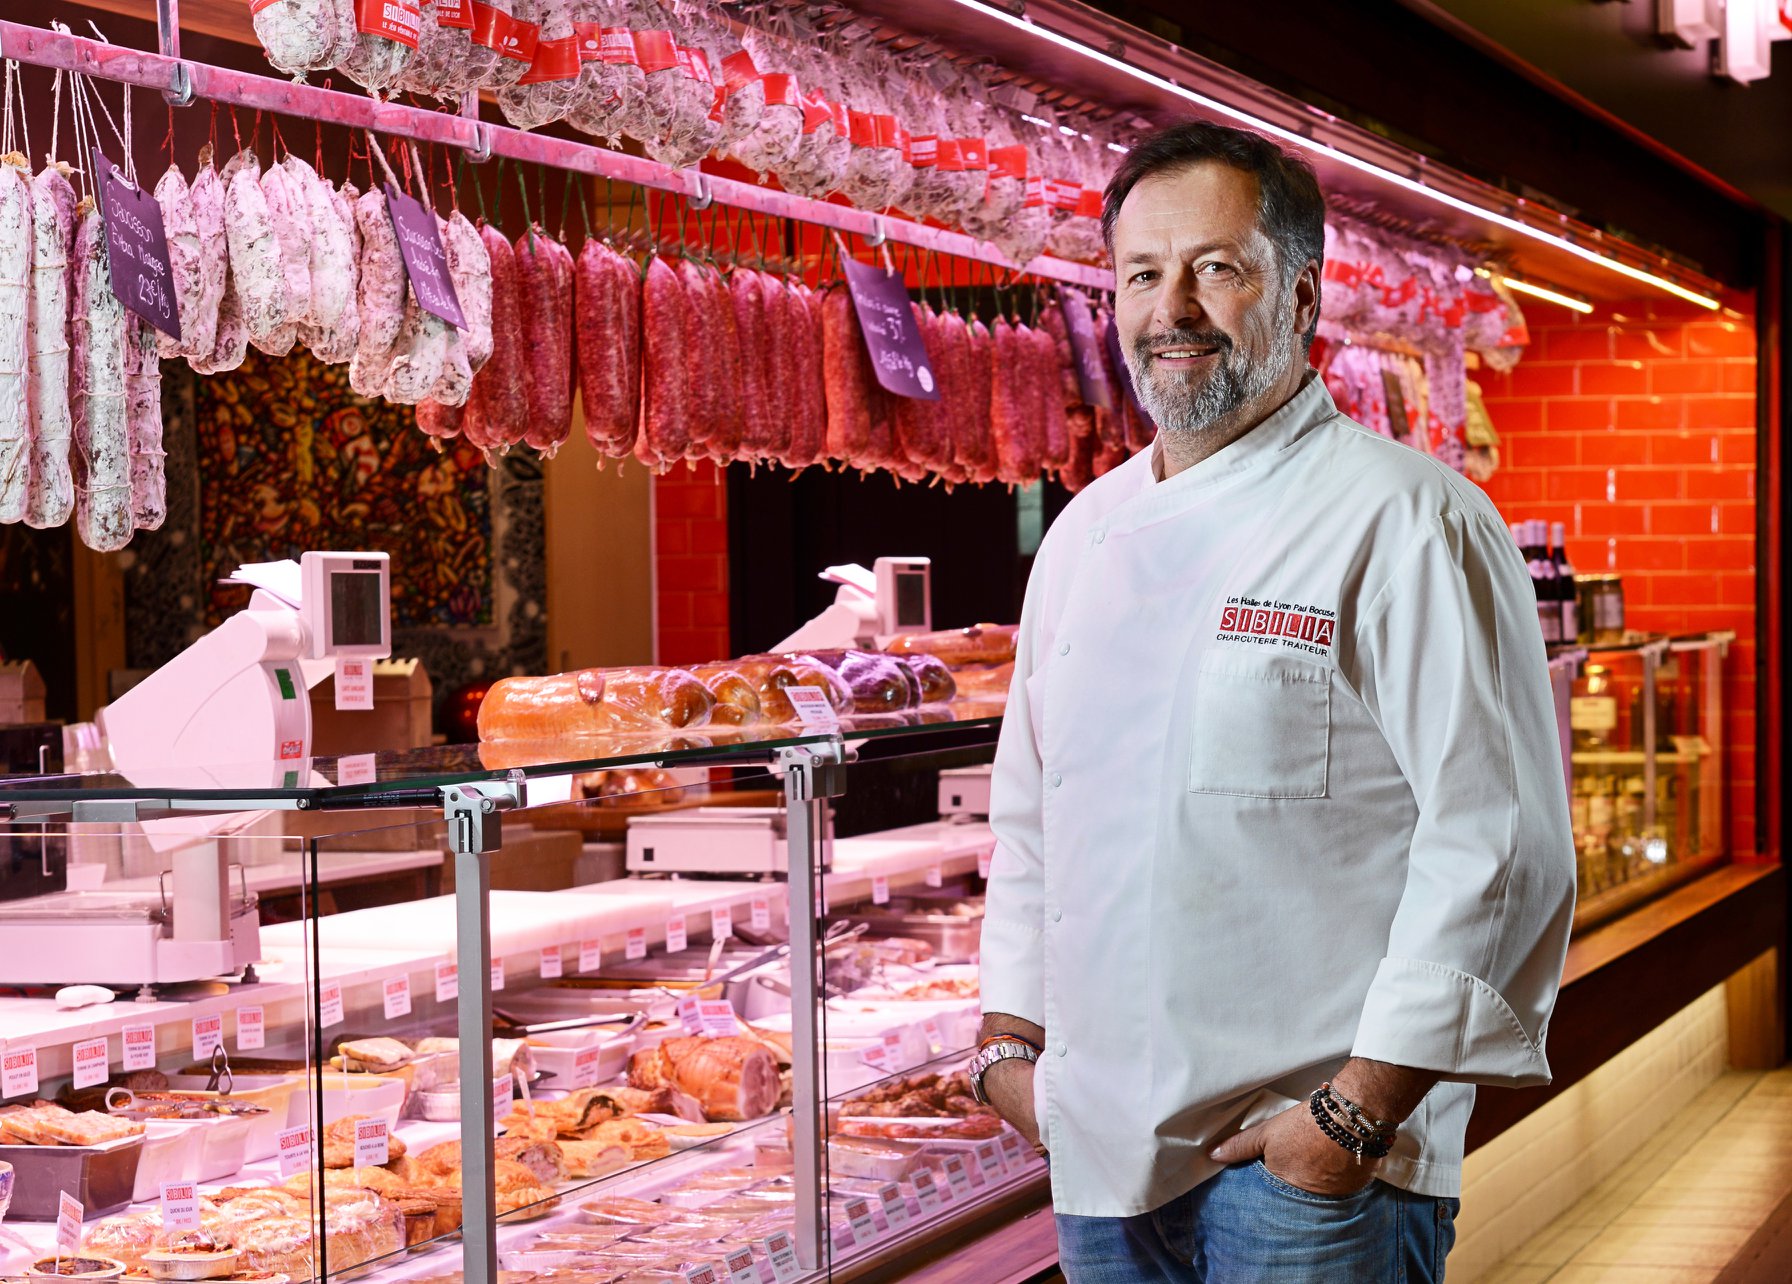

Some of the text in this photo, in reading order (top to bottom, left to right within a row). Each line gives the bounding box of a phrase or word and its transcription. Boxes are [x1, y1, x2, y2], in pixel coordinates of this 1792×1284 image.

[1227, 596, 1335, 618] Les Halles de Lyon Paul Bocuse
[1220, 607, 1334, 645] SIBILIA
[1216, 633, 1328, 657] CHARCUTERIE TRAITEUR
[4, 1053, 34, 1070] SIBILIA
[359, 1124, 386, 1140] SIBILIA
[166, 1187, 193, 1200] SIBILIA
